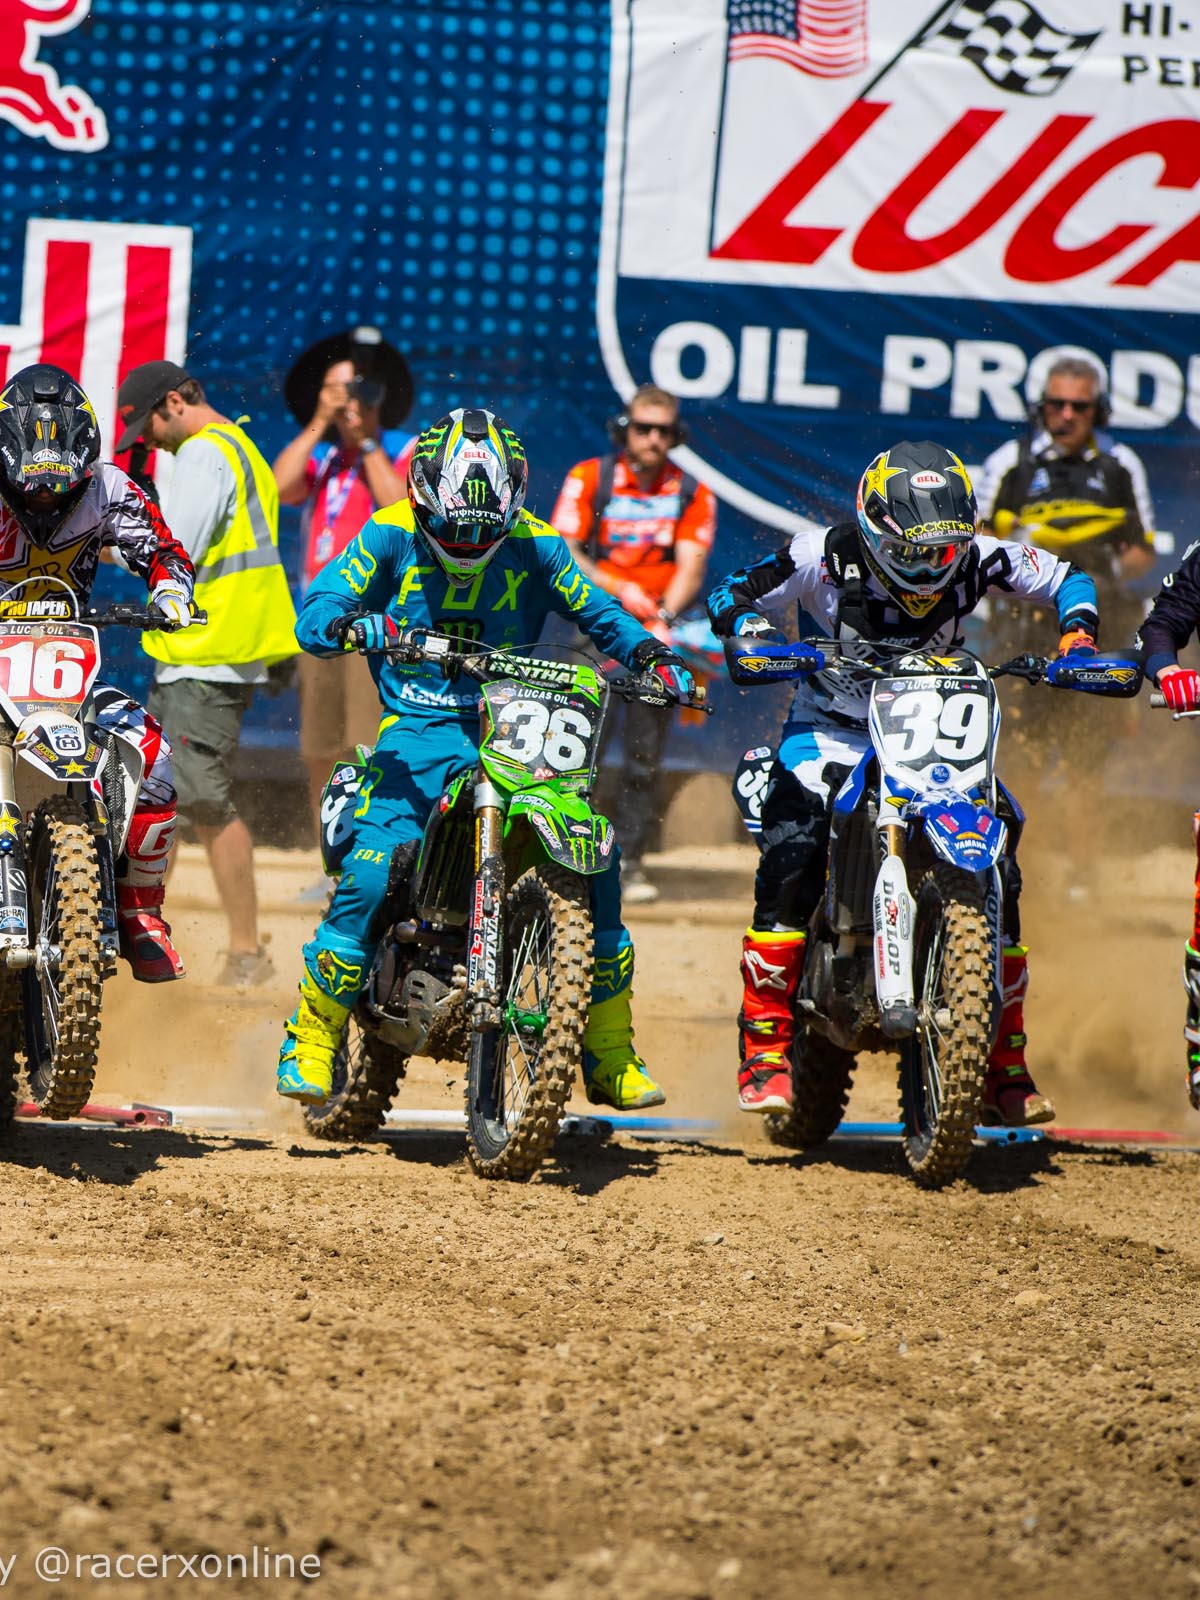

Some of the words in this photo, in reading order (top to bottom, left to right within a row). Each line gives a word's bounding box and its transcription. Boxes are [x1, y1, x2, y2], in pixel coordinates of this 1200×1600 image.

[709, 100, 1200, 288] LUC
[649, 320, 840, 409] OIL
[880, 335, 1200, 431] PROD
[463, 450, 489, 460] BELL
[916, 475, 941, 484] BELL
[448, 508, 504, 523] MONSTER
[904, 520, 975, 541] ROCKSTAR
[396, 565, 529, 612] FOX
[9, 625, 45, 635] LUCS
[46, 625, 65, 635] OIL
[907, 680, 942, 690] LUCAS
[943, 679, 961, 690] OIL
[400, 682, 482, 707] Kawasa
[517, 688, 553, 700] LUCAS
[553, 693, 569, 705] OIL
[884, 690, 989, 761] 39
[492, 700, 592, 771] 36
[953, 839, 988, 851] YAMAHA
[353, 848, 386, 866] FOX
